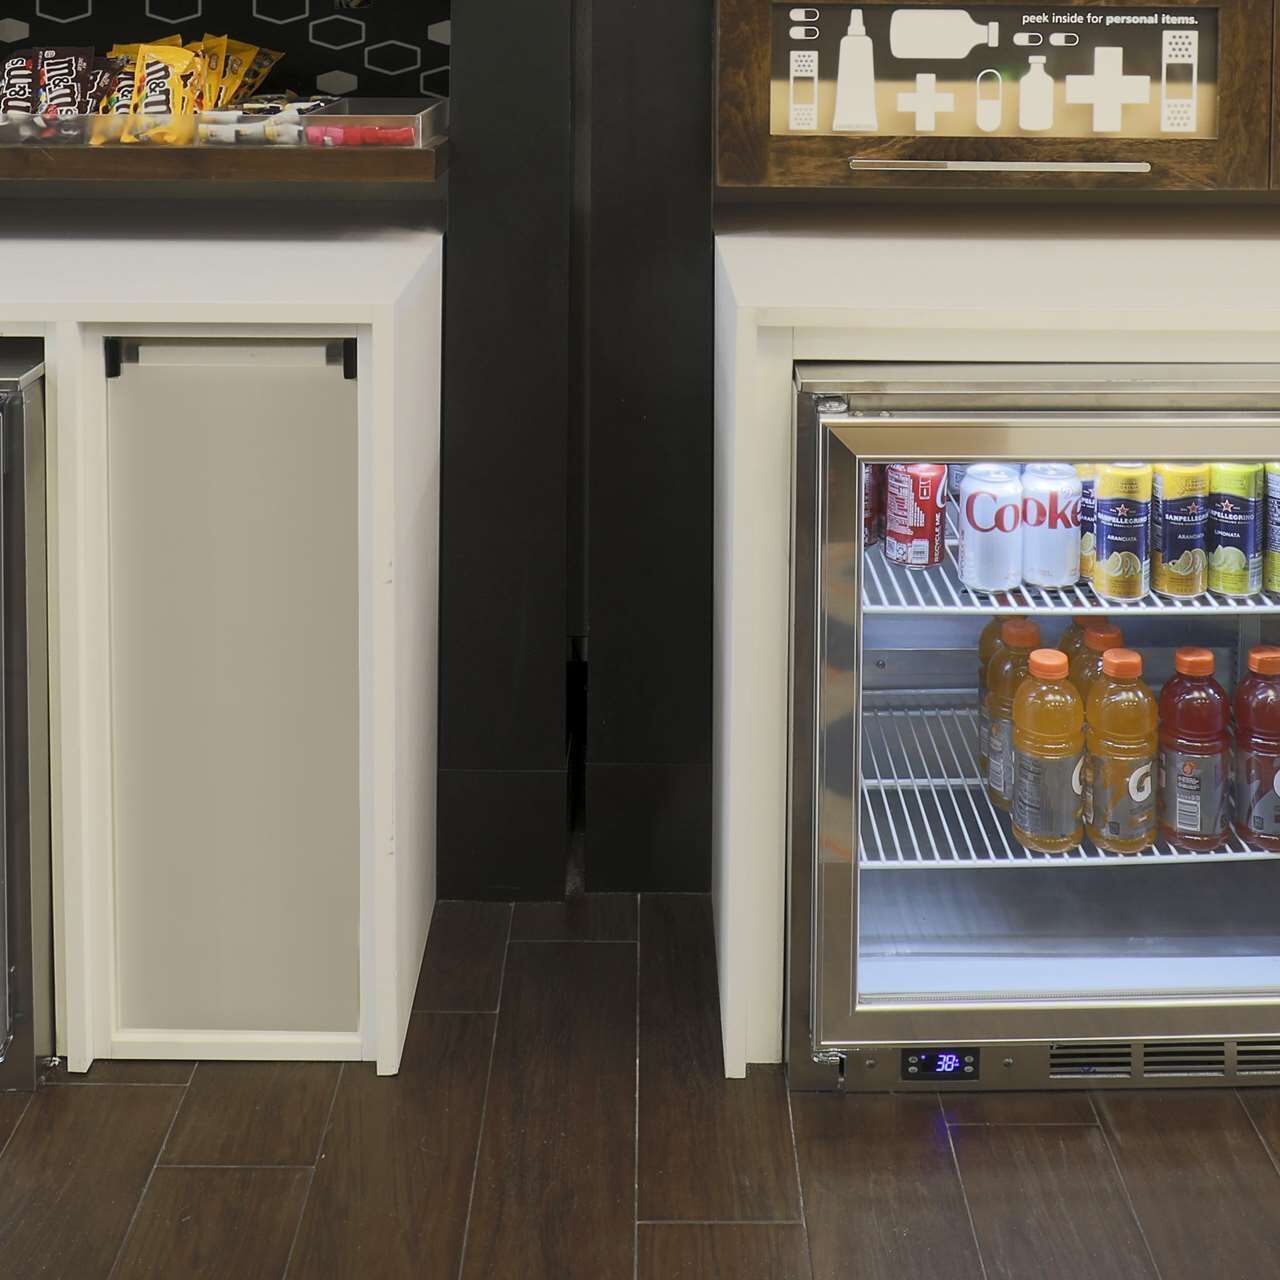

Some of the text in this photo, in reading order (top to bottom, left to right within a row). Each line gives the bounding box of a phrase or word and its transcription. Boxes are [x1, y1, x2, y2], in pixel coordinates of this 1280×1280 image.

[1022, 12, 1199, 26] peek inside for personal items.
[935, 1054, 957, 1072] 38
